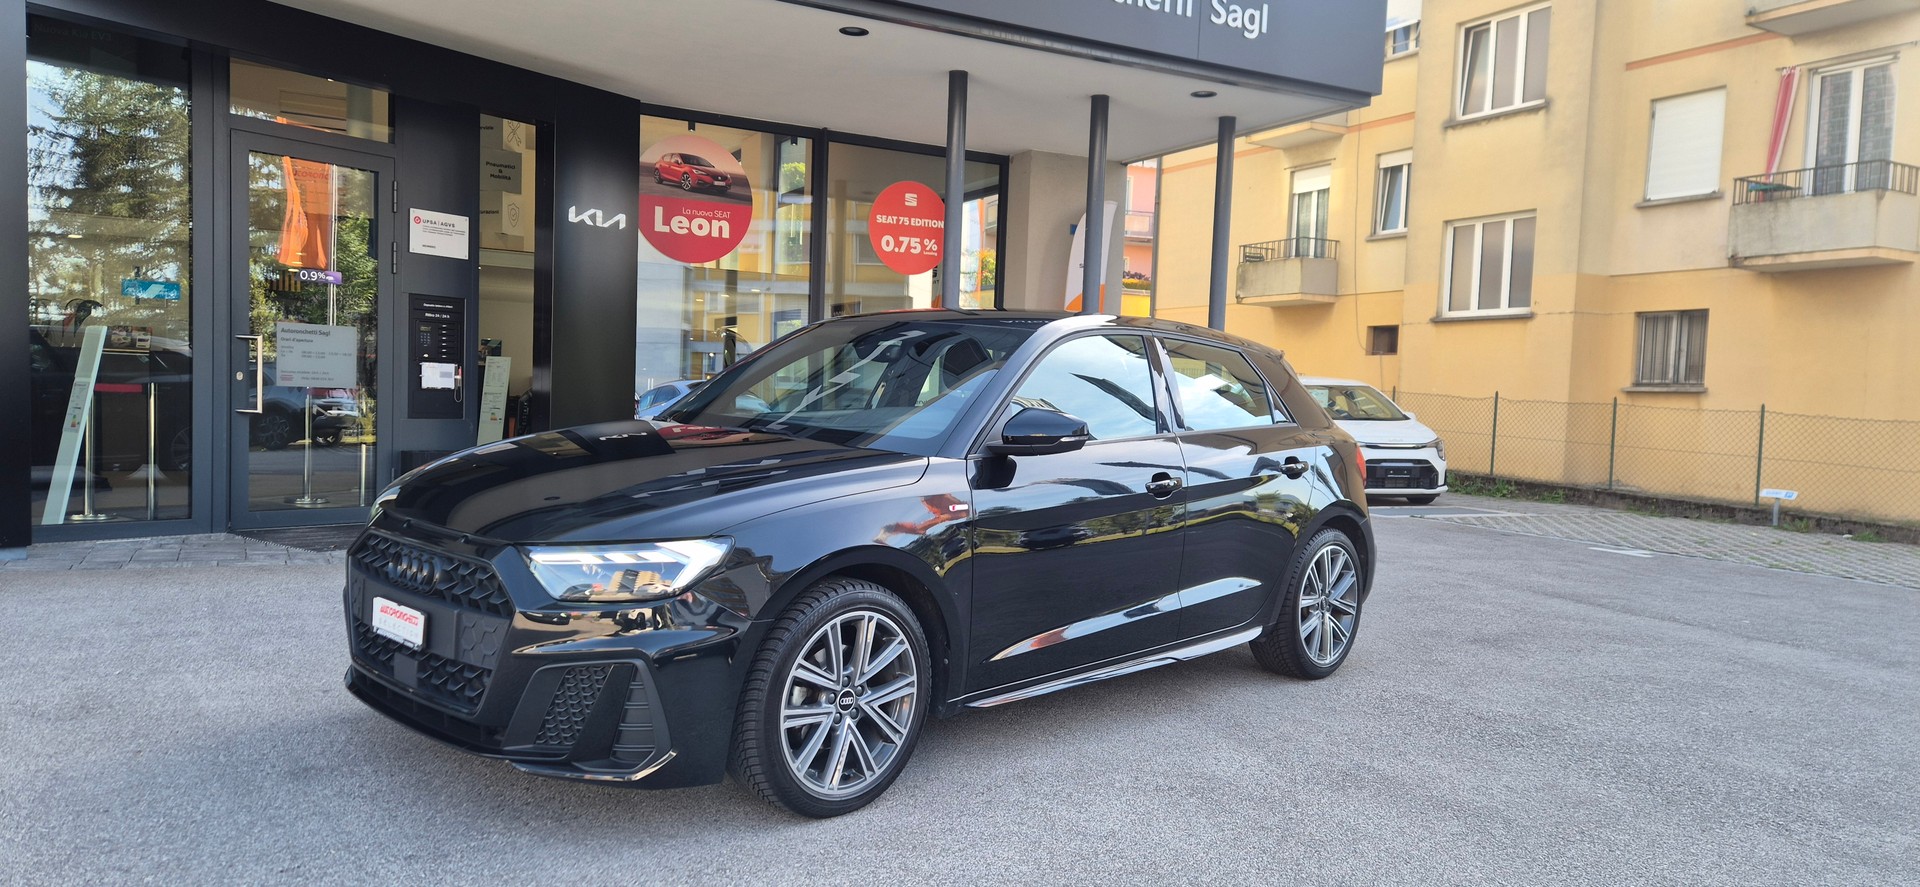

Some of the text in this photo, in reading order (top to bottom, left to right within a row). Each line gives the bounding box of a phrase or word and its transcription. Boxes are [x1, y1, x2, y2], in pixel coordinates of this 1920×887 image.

[1211, 0, 1269, 39] Sagl
[486, 161, 516, 170] Pneumatici
[568, 205, 626, 230] KIA
[682, 207, 691, 215] La
[714, 210, 731, 219] SEAT
[440, 221, 456, 229] AGVS
[654, 205, 730, 239] Leon
[876, 214, 944, 229] SEAT 75 EDITION
[881, 234, 938, 255] 0.75 %
[300, 270, 326, 282] 0.9%
[281, 327, 331, 338] Autoronchetti Sagl
